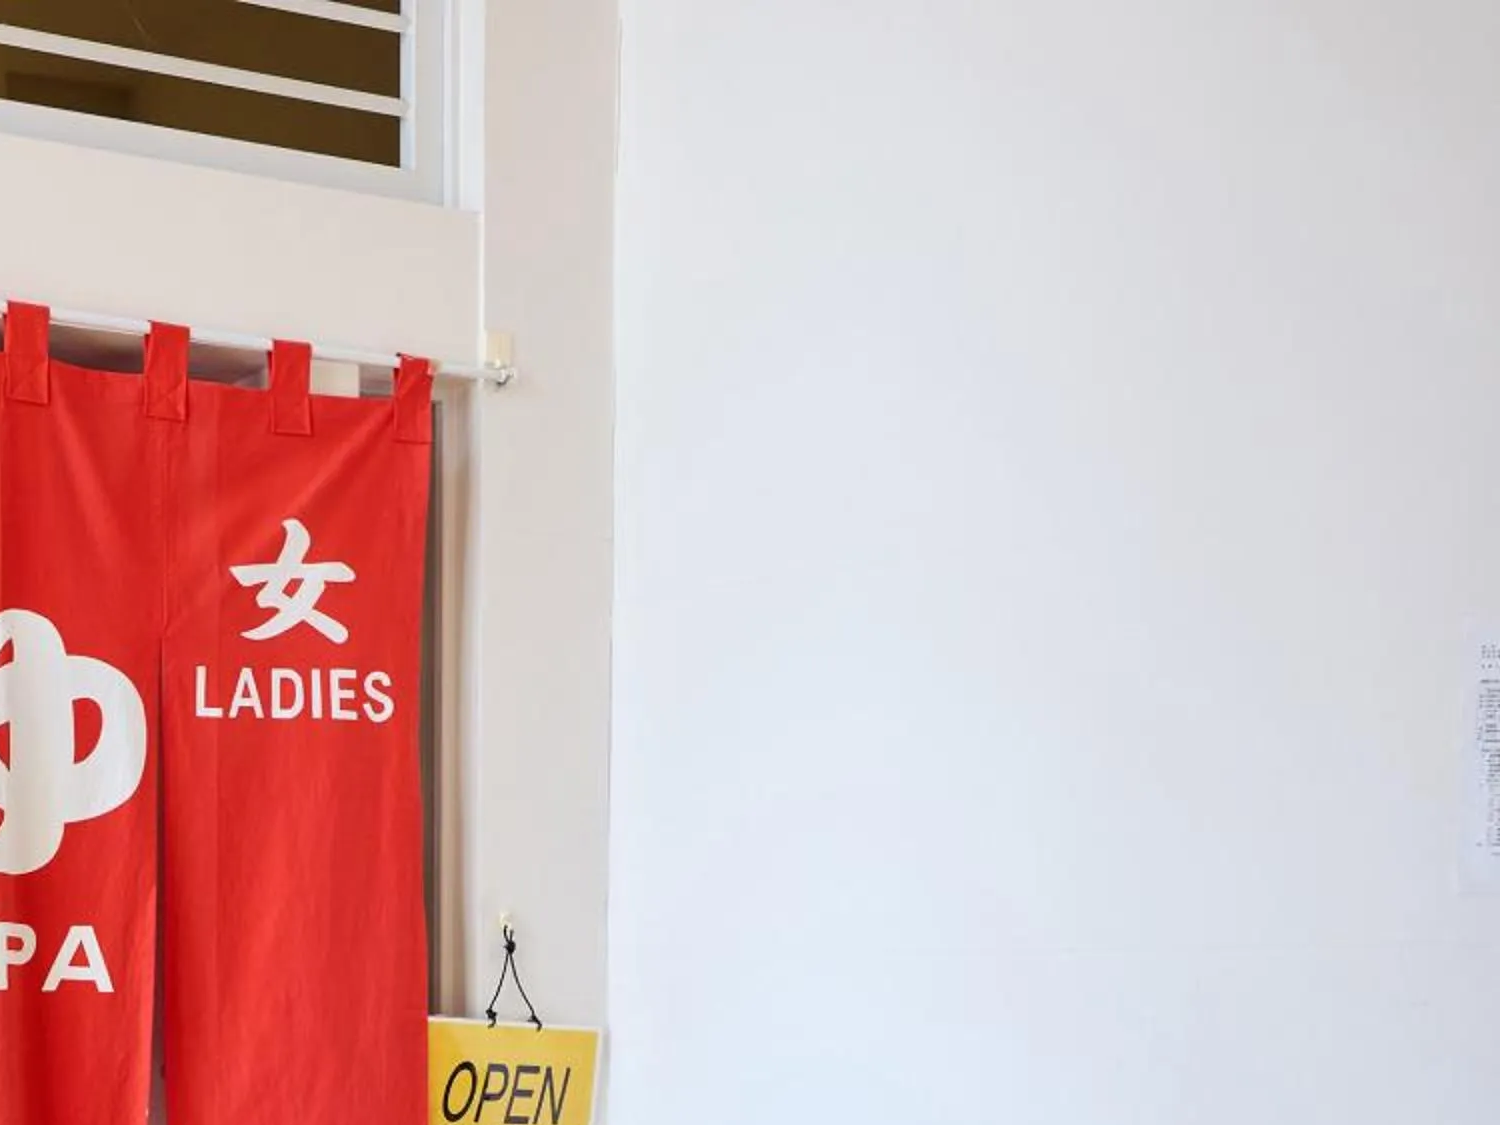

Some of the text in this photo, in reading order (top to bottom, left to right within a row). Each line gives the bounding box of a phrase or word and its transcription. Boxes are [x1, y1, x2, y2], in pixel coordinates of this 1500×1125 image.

[229, 518, 357, 645] 女
[195, 665, 395, 724] LADIES
[442, 1061, 572, 1125] OPEN
